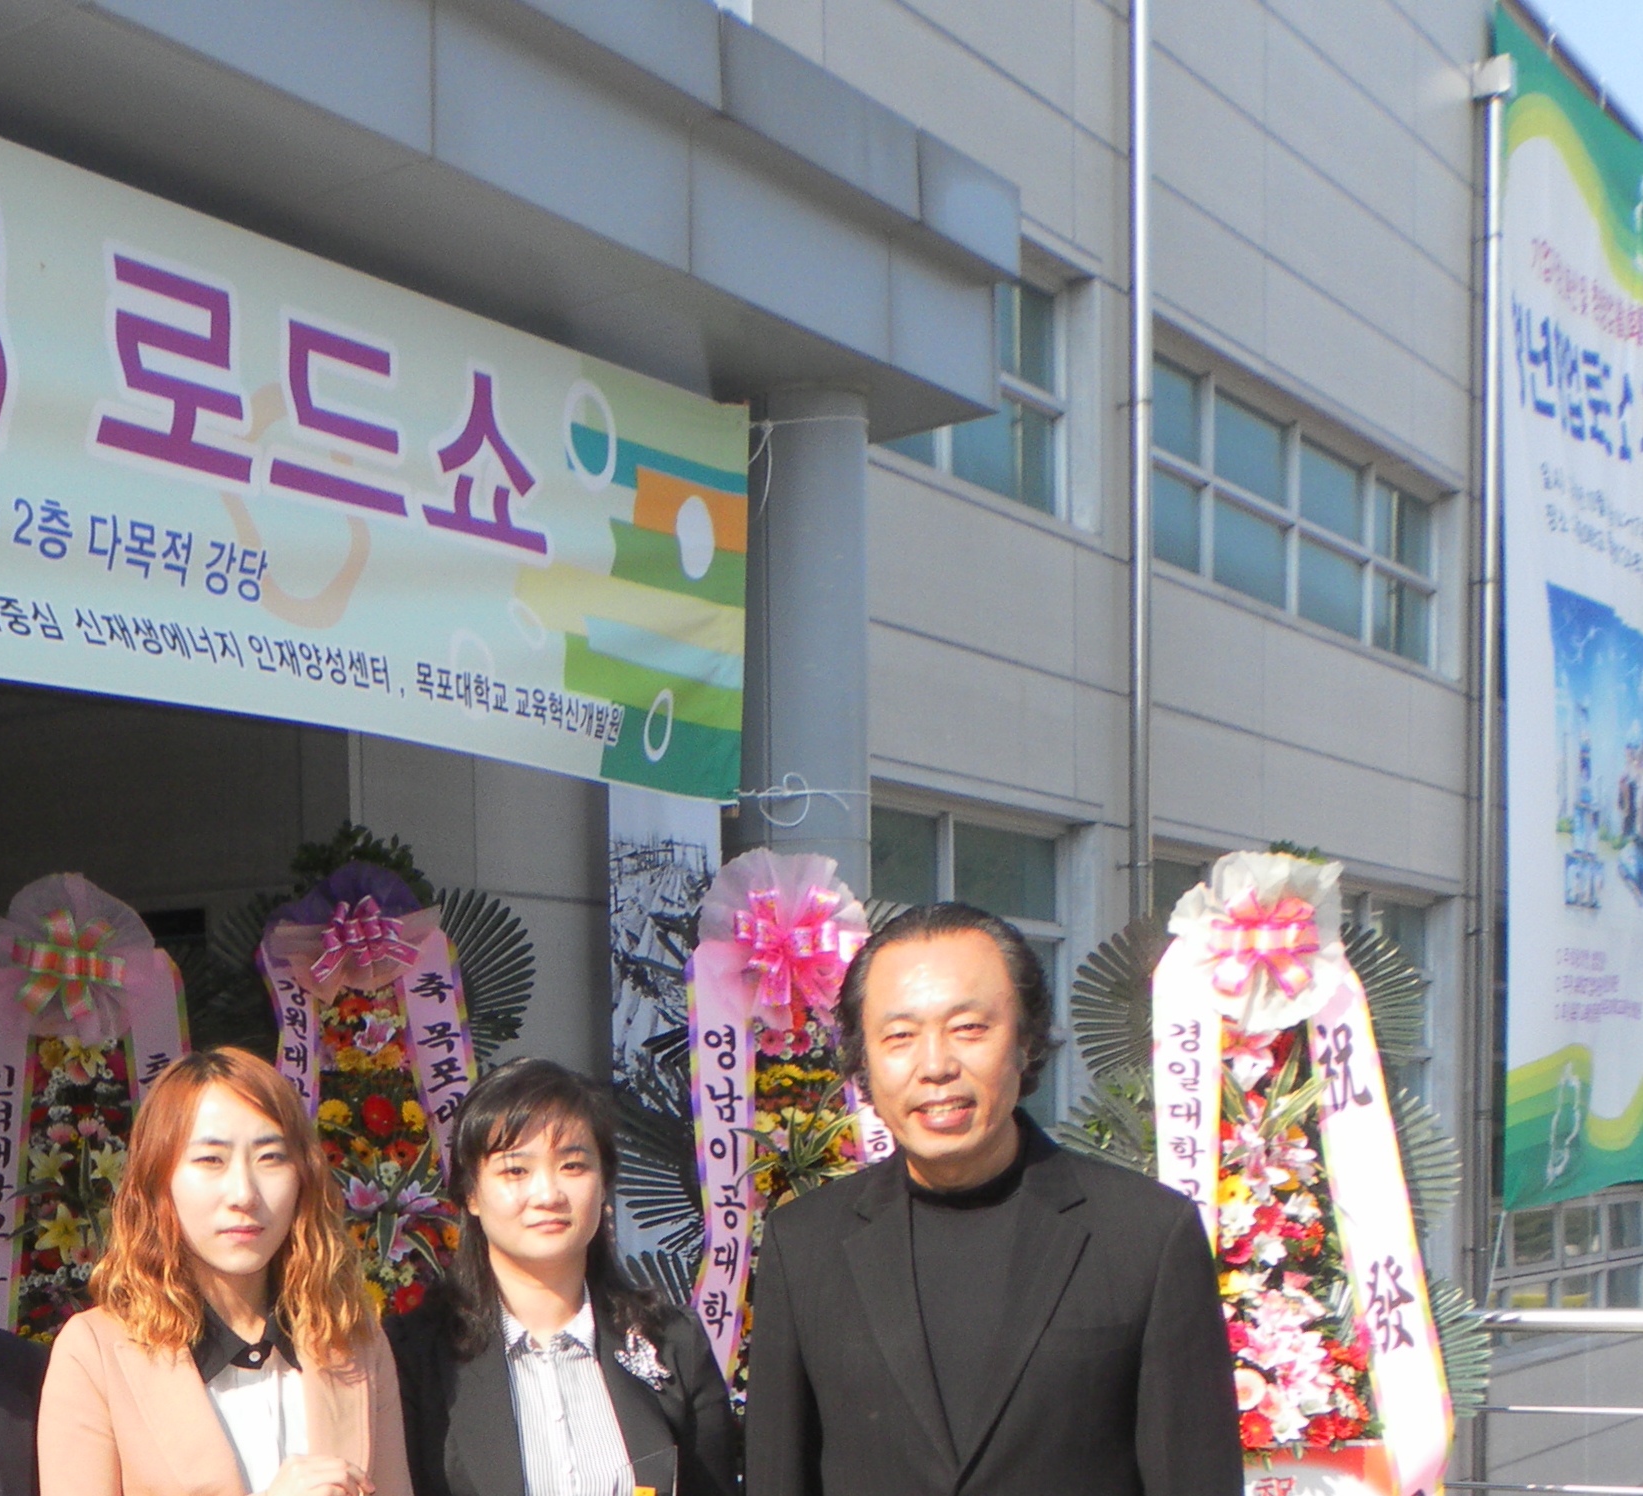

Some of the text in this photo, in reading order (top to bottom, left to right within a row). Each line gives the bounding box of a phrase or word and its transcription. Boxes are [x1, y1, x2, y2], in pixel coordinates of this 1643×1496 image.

[96, 253, 548, 555] 로드쇼
[13, 497, 74, 559] 2층
[87, 514, 193, 586] 다목적
[205, 540, 268, 603] 강당
[75, 607, 245, 668] 신재생에너지
[416, 661, 509, 713] 목포대학교
[410, 972, 468, 1149] 축 목포대
[1319, 1024, 1373, 1112] 祝
